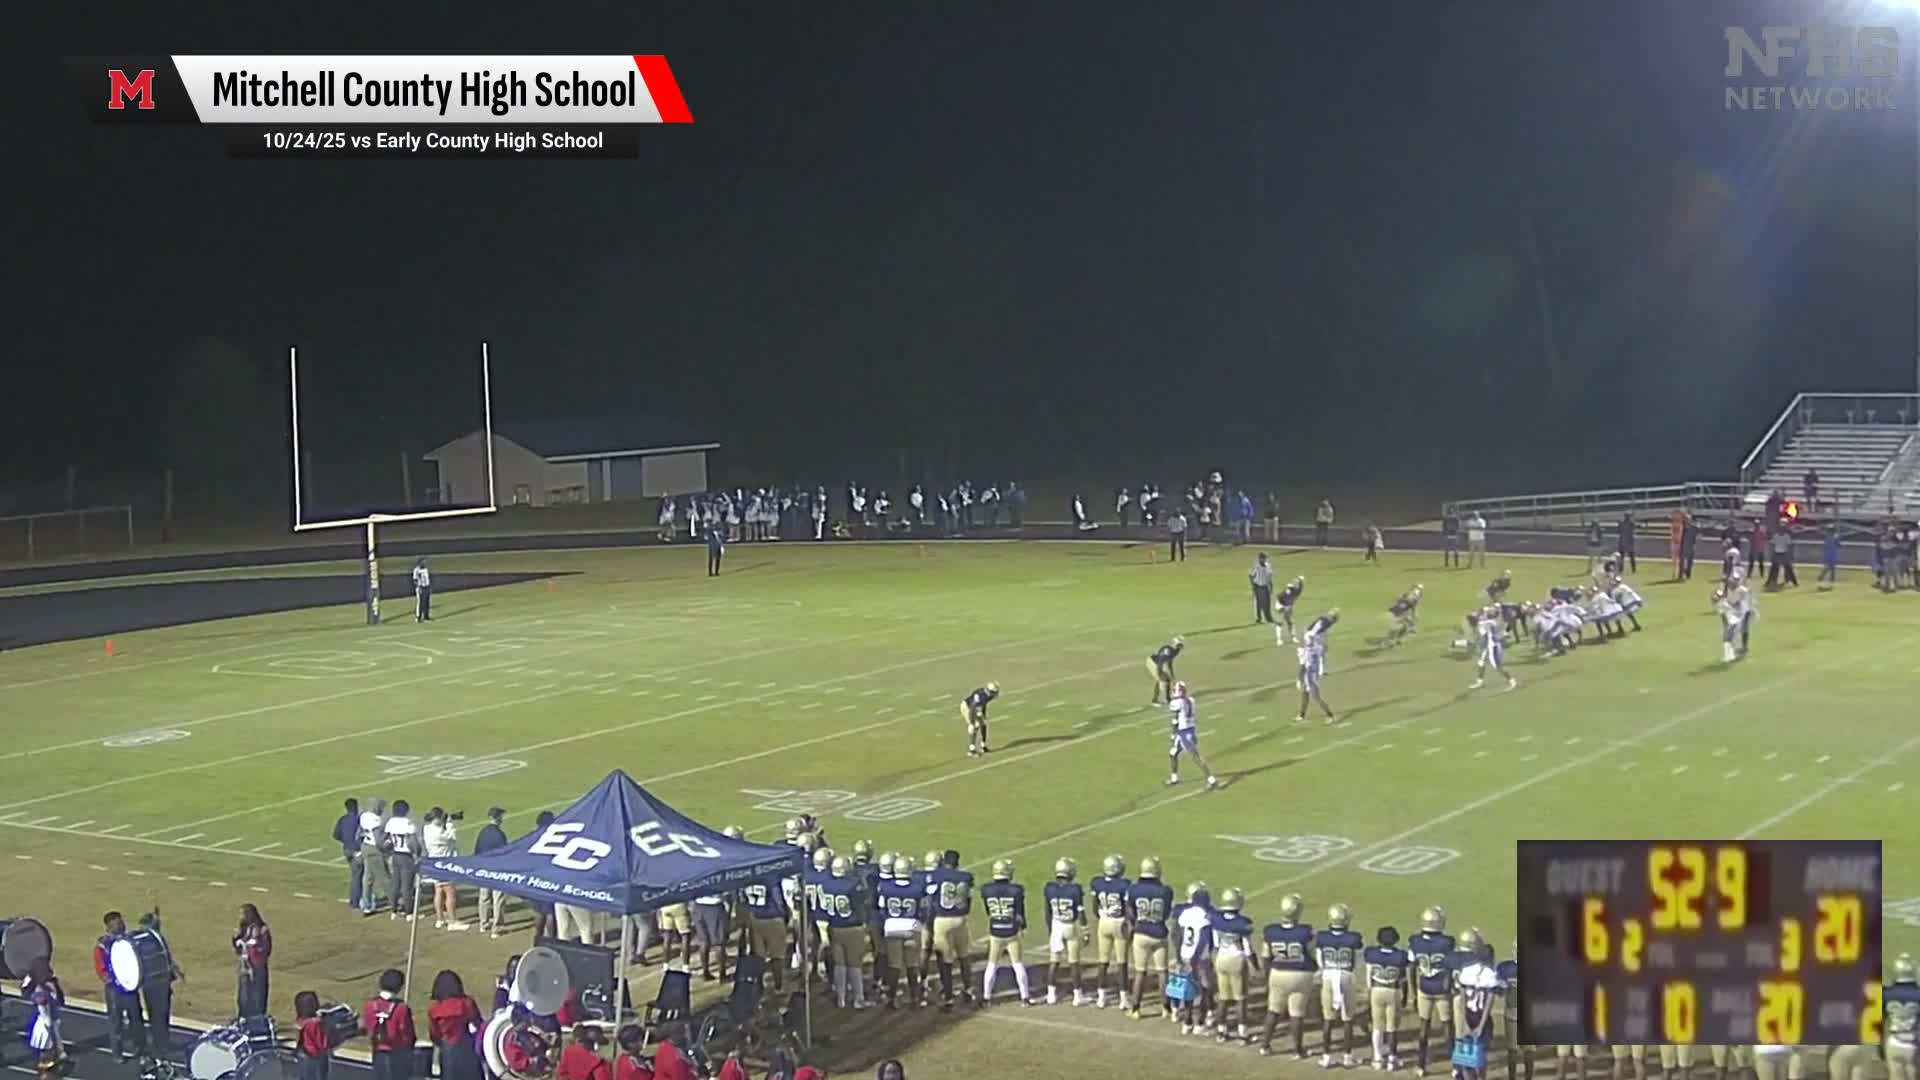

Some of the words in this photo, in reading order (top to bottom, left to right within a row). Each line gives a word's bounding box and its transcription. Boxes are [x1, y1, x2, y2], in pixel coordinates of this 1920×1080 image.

[528, 822, 612, 871] EC
[630, 821, 721, 858] EC
[527, 876, 560, 892] HIGH
[562, 884, 615, 903] SCHOOL
[1621, 918, 1644, 973] 2
[1780, 918, 1802, 973] 3
